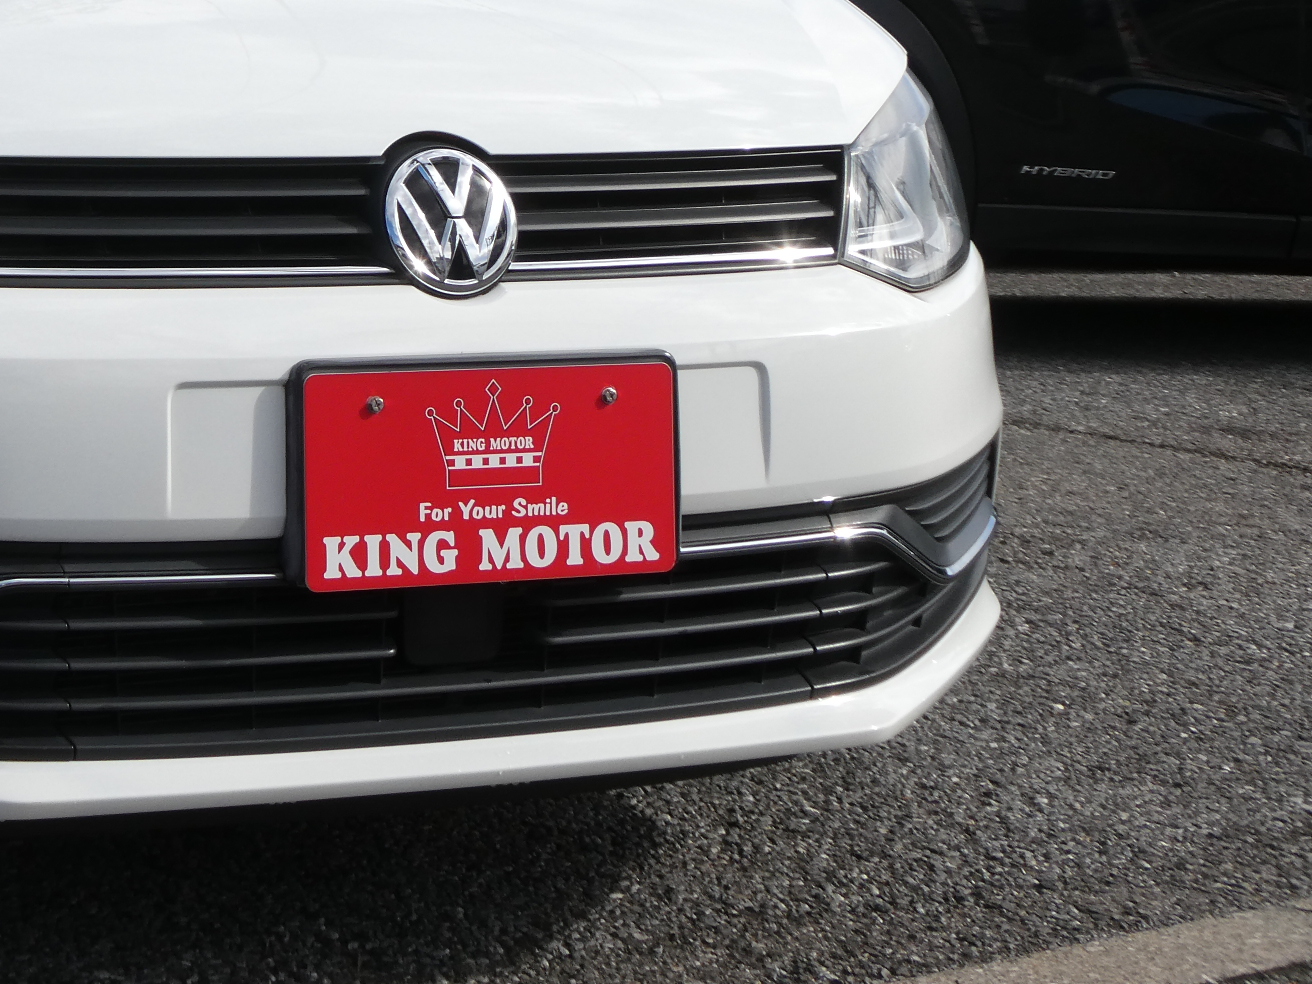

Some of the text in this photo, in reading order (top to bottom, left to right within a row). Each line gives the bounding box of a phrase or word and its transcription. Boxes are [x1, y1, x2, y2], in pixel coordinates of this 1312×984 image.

[1020, 165, 1116, 180] HYBRID
[453, 436, 534, 452] KING MOTOR
[419, 496, 569, 522] For Your Smile
[323, 520, 660, 579] KING MOTOR
